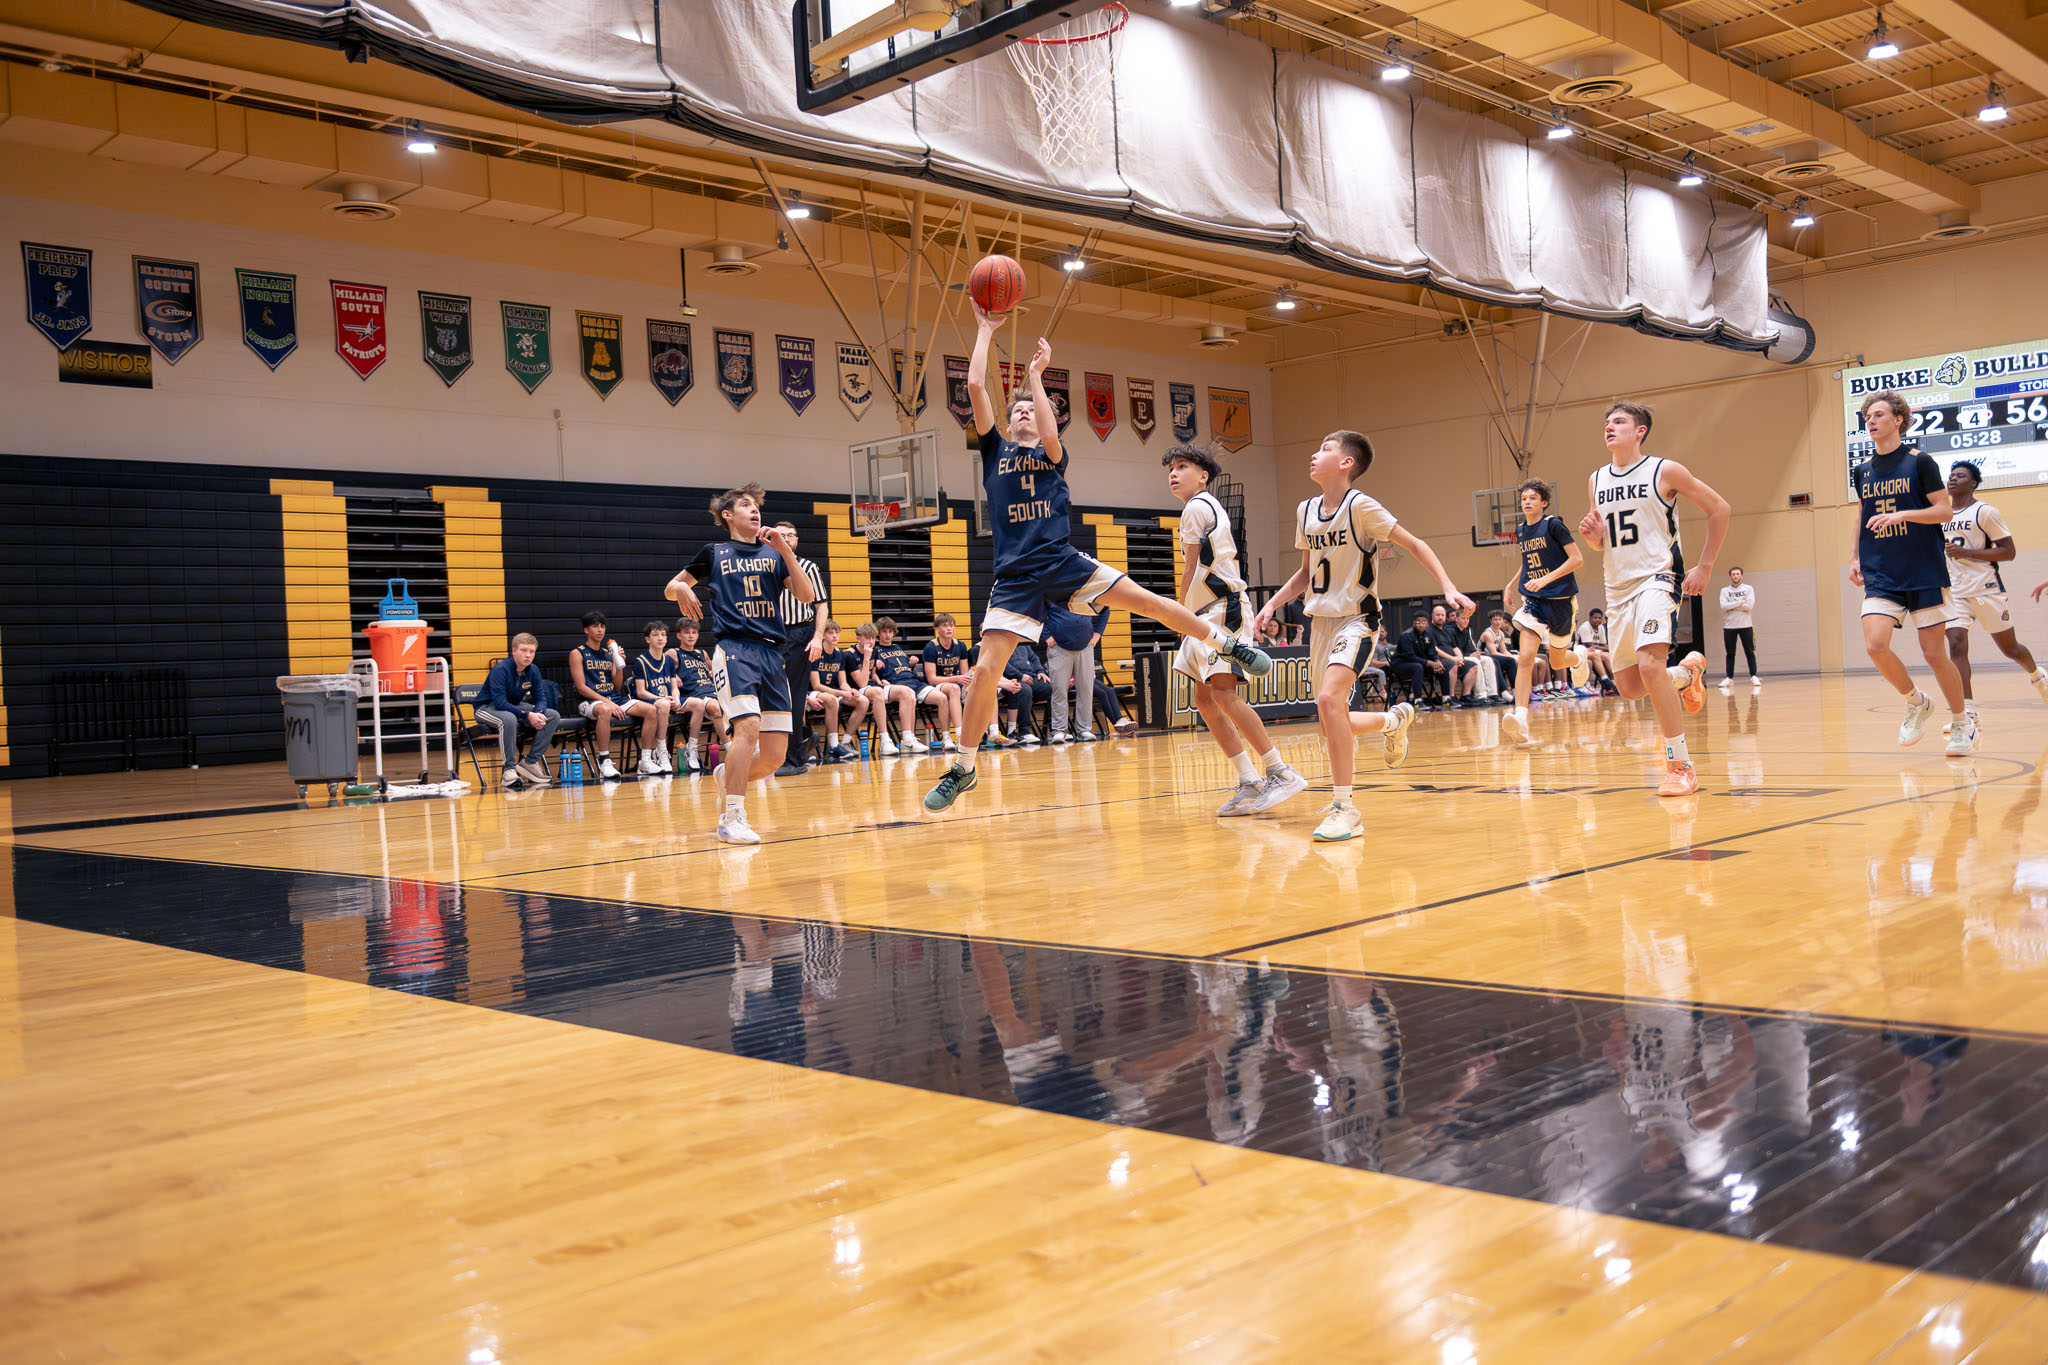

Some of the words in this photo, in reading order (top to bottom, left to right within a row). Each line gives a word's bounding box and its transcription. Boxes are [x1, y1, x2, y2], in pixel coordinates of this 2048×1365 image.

[28, 250, 87, 267] CREIGHTON
[39, 264, 78, 278] PREP
[140, 265, 193, 280] ELKHORN
[144, 279, 190, 293] SOUTH
[240, 275, 292, 290] MILLARD
[246, 289, 289, 303] NORTH
[336, 289, 383, 302] MILLARD
[166, 308, 192, 317] STORM
[341, 302, 380, 314] SOUTH
[423, 299, 468, 313] MILLARD
[507, 307, 545, 320] OMAHA
[57, 315, 87, 330] JAYS
[429, 311, 462, 325] WEST
[506, 318, 547, 331] BENSON
[148, 326, 193, 342] STORM
[342, 341, 385, 359] PATRIOTS
[781, 341, 810, 351] OMAHA
[62, 349, 151, 375] VISITOR
[780, 350, 814, 361] CENTRAL
[1850, 369, 1929, 394] BURKE
[1973, 352, 2048, 377] BULLD
[786, 386, 811, 399] EAGLES
[2018, 379, 2048, 392] STOR
[1907, 393, 1950, 407] LLDOGS
[2006, 397, 2048, 425] 56
[1904, 410, 1945, 438] 22
[1969, 412, 1980, 426] 4
[1950, 429, 2001, 449] 05:28
[1021, 474, 1035, 498] 4
[1862, 477, 1911, 500] ELKHORN
[1598, 484, 1648, 505] BURKE
[1605, 508, 1639, 548] 15
[720, 557, 777, 576] ELKHORN
[1526, 552, 1542, 569] 30
[1311, 557, 1331, 595] 0
[742, 575, 762, 598] 10
[735, 600, 776, 618] SOUTH
[599, 671, 606, 684] 3
[650, 674, 671, 687] STORM
